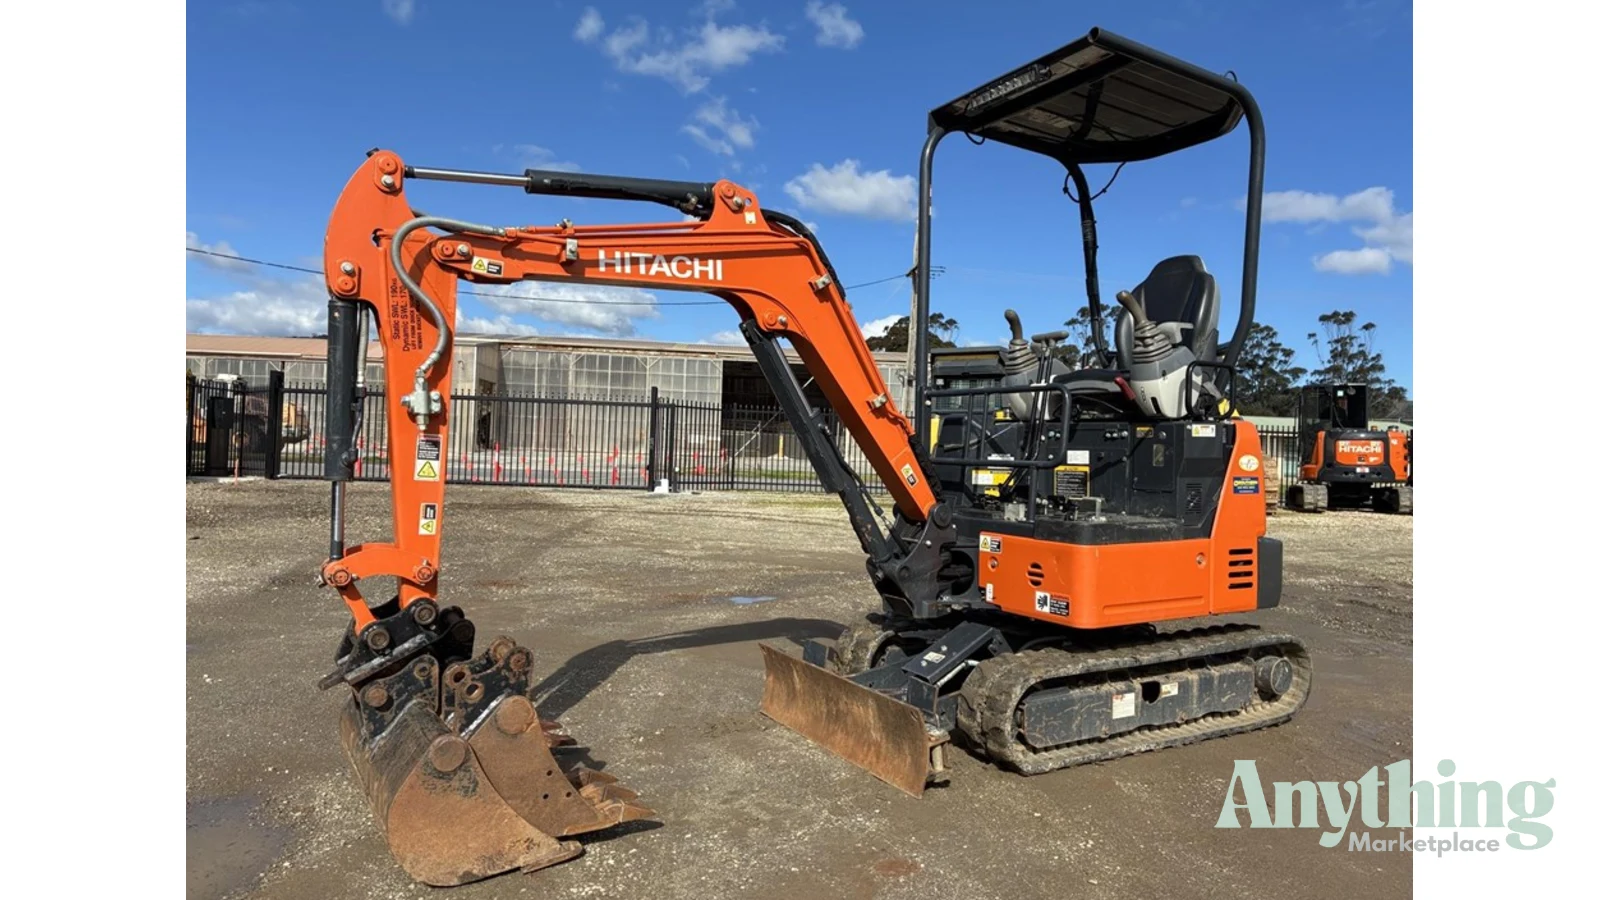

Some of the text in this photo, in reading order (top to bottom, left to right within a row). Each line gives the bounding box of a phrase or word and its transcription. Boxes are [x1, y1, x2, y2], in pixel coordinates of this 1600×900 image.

[598, 249, 722, 280] HITACHI
[392, 320, 400, 340] Static
[401, 321, 411, 352] Dynamic
[1338, 444, 1382, 453] HITACHI
